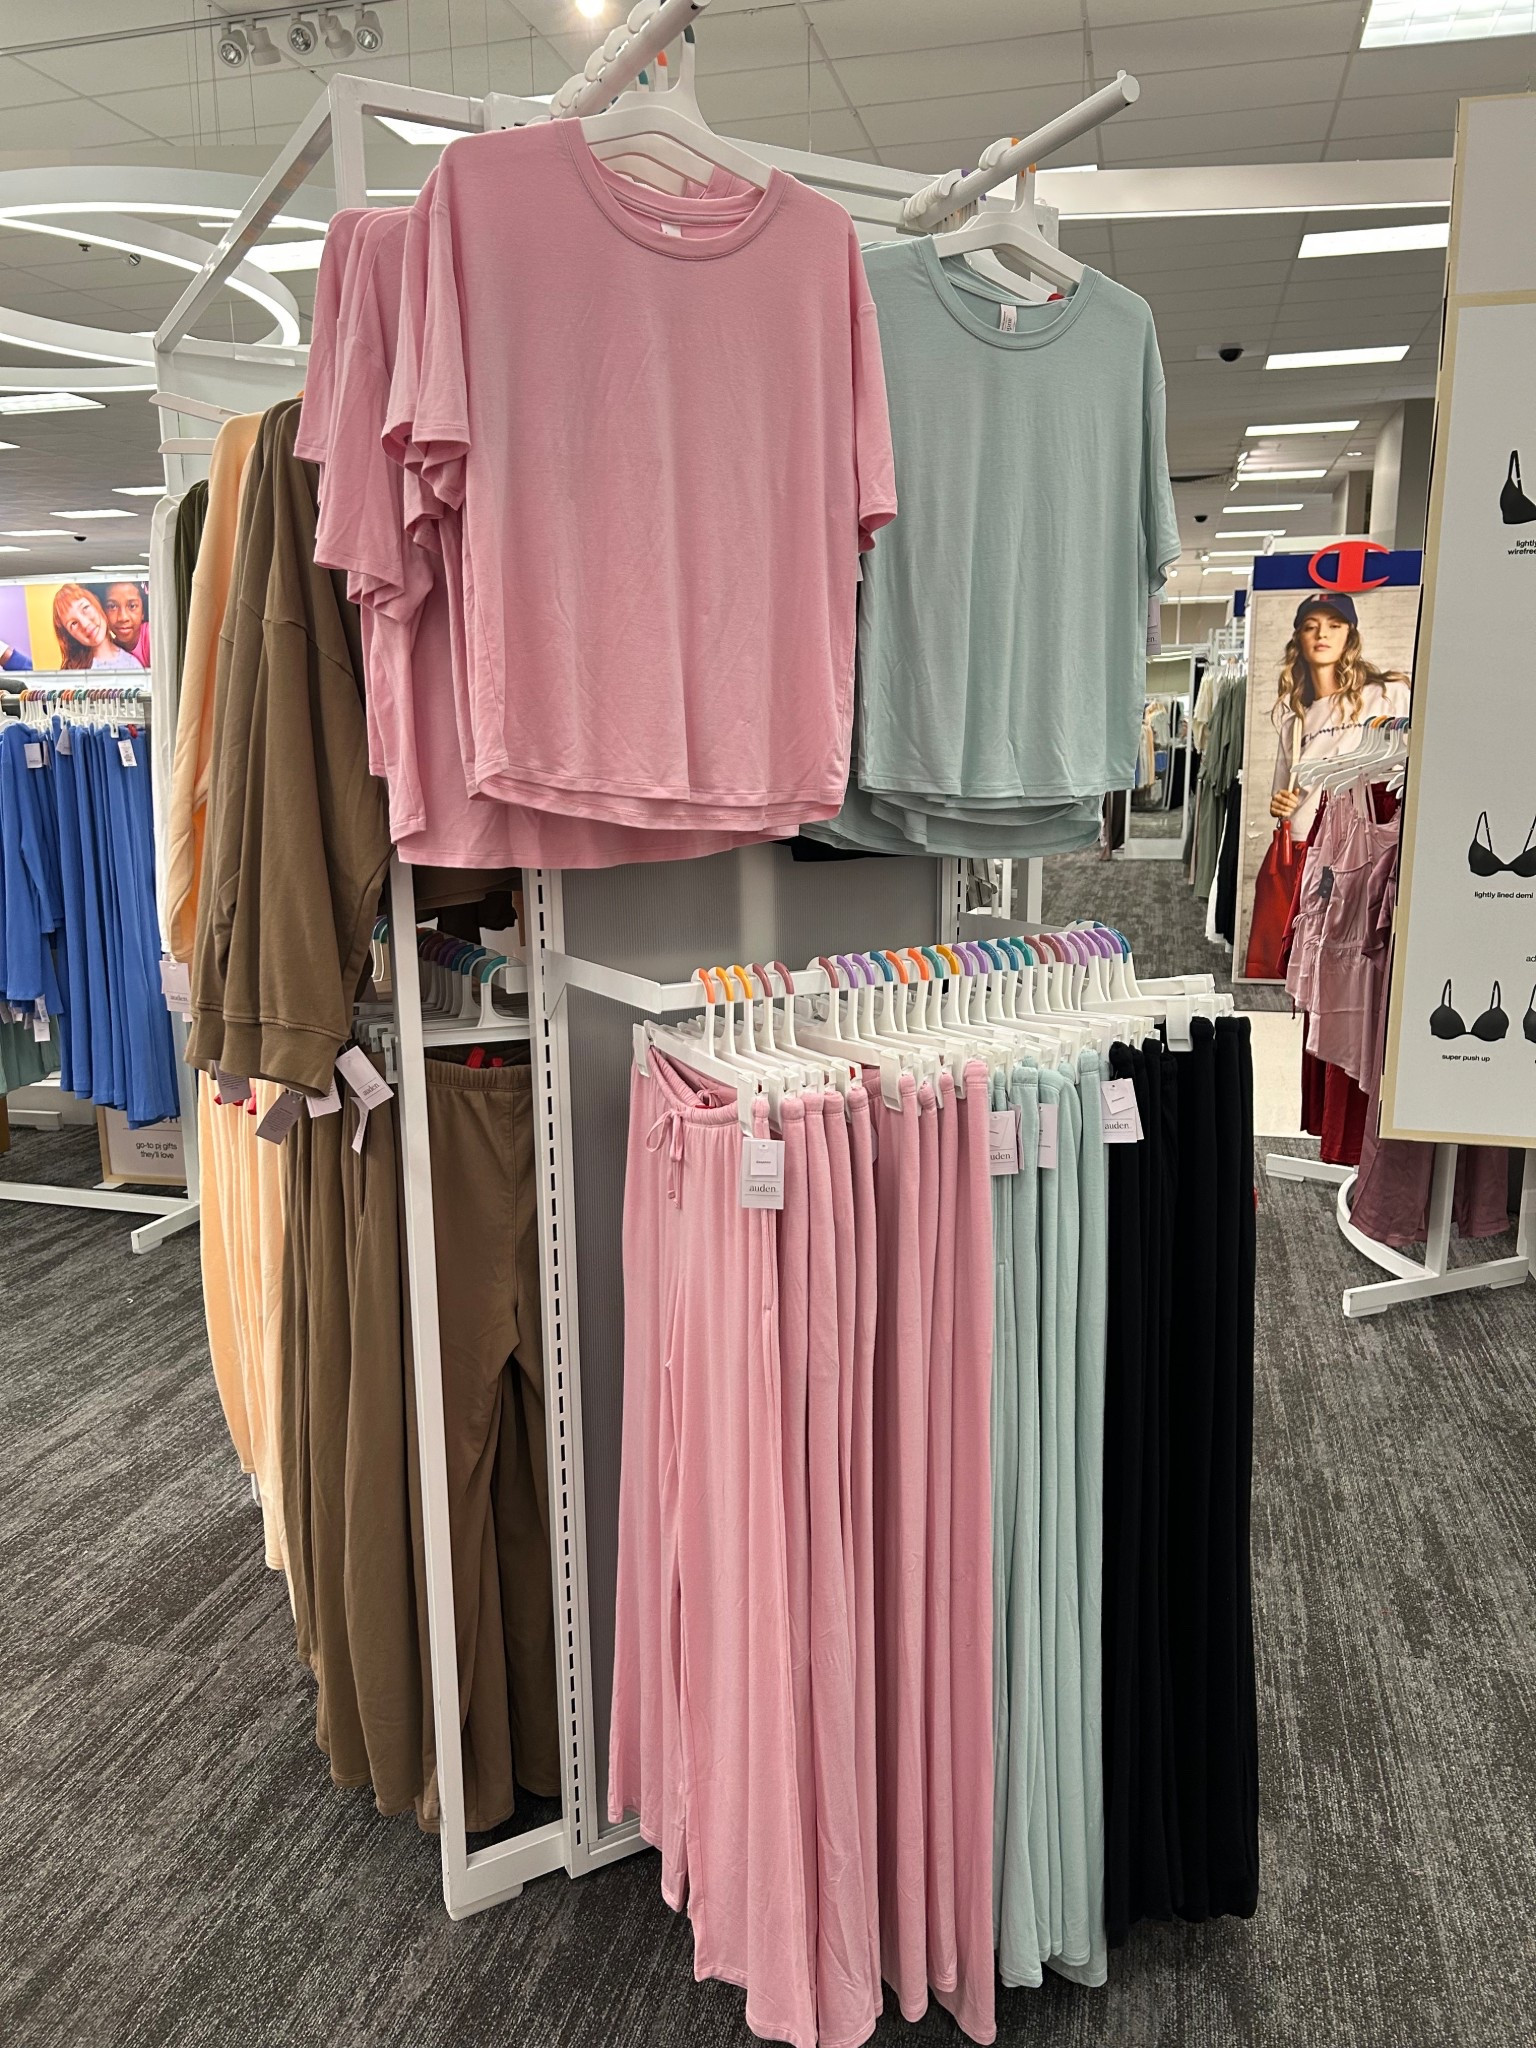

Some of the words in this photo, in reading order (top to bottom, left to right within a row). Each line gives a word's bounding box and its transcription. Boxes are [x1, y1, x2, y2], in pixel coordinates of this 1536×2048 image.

[1474, 890, 1496, 899] lightly
[1497, 891, 1514, 899] lined
[1515, 891, 1534, 899] demi
[1462, 1054, 1480, 1062] push
[135, 1141, 154, 1150] go-to
[155, 1141, 162, 1150] pj
[163, 1142, 178, 1151] gifts
[140, 1151, 159, 1160] they'll
[160, 1151, 174, 1159] love
[990, 1151, 1011, 1161] uden
